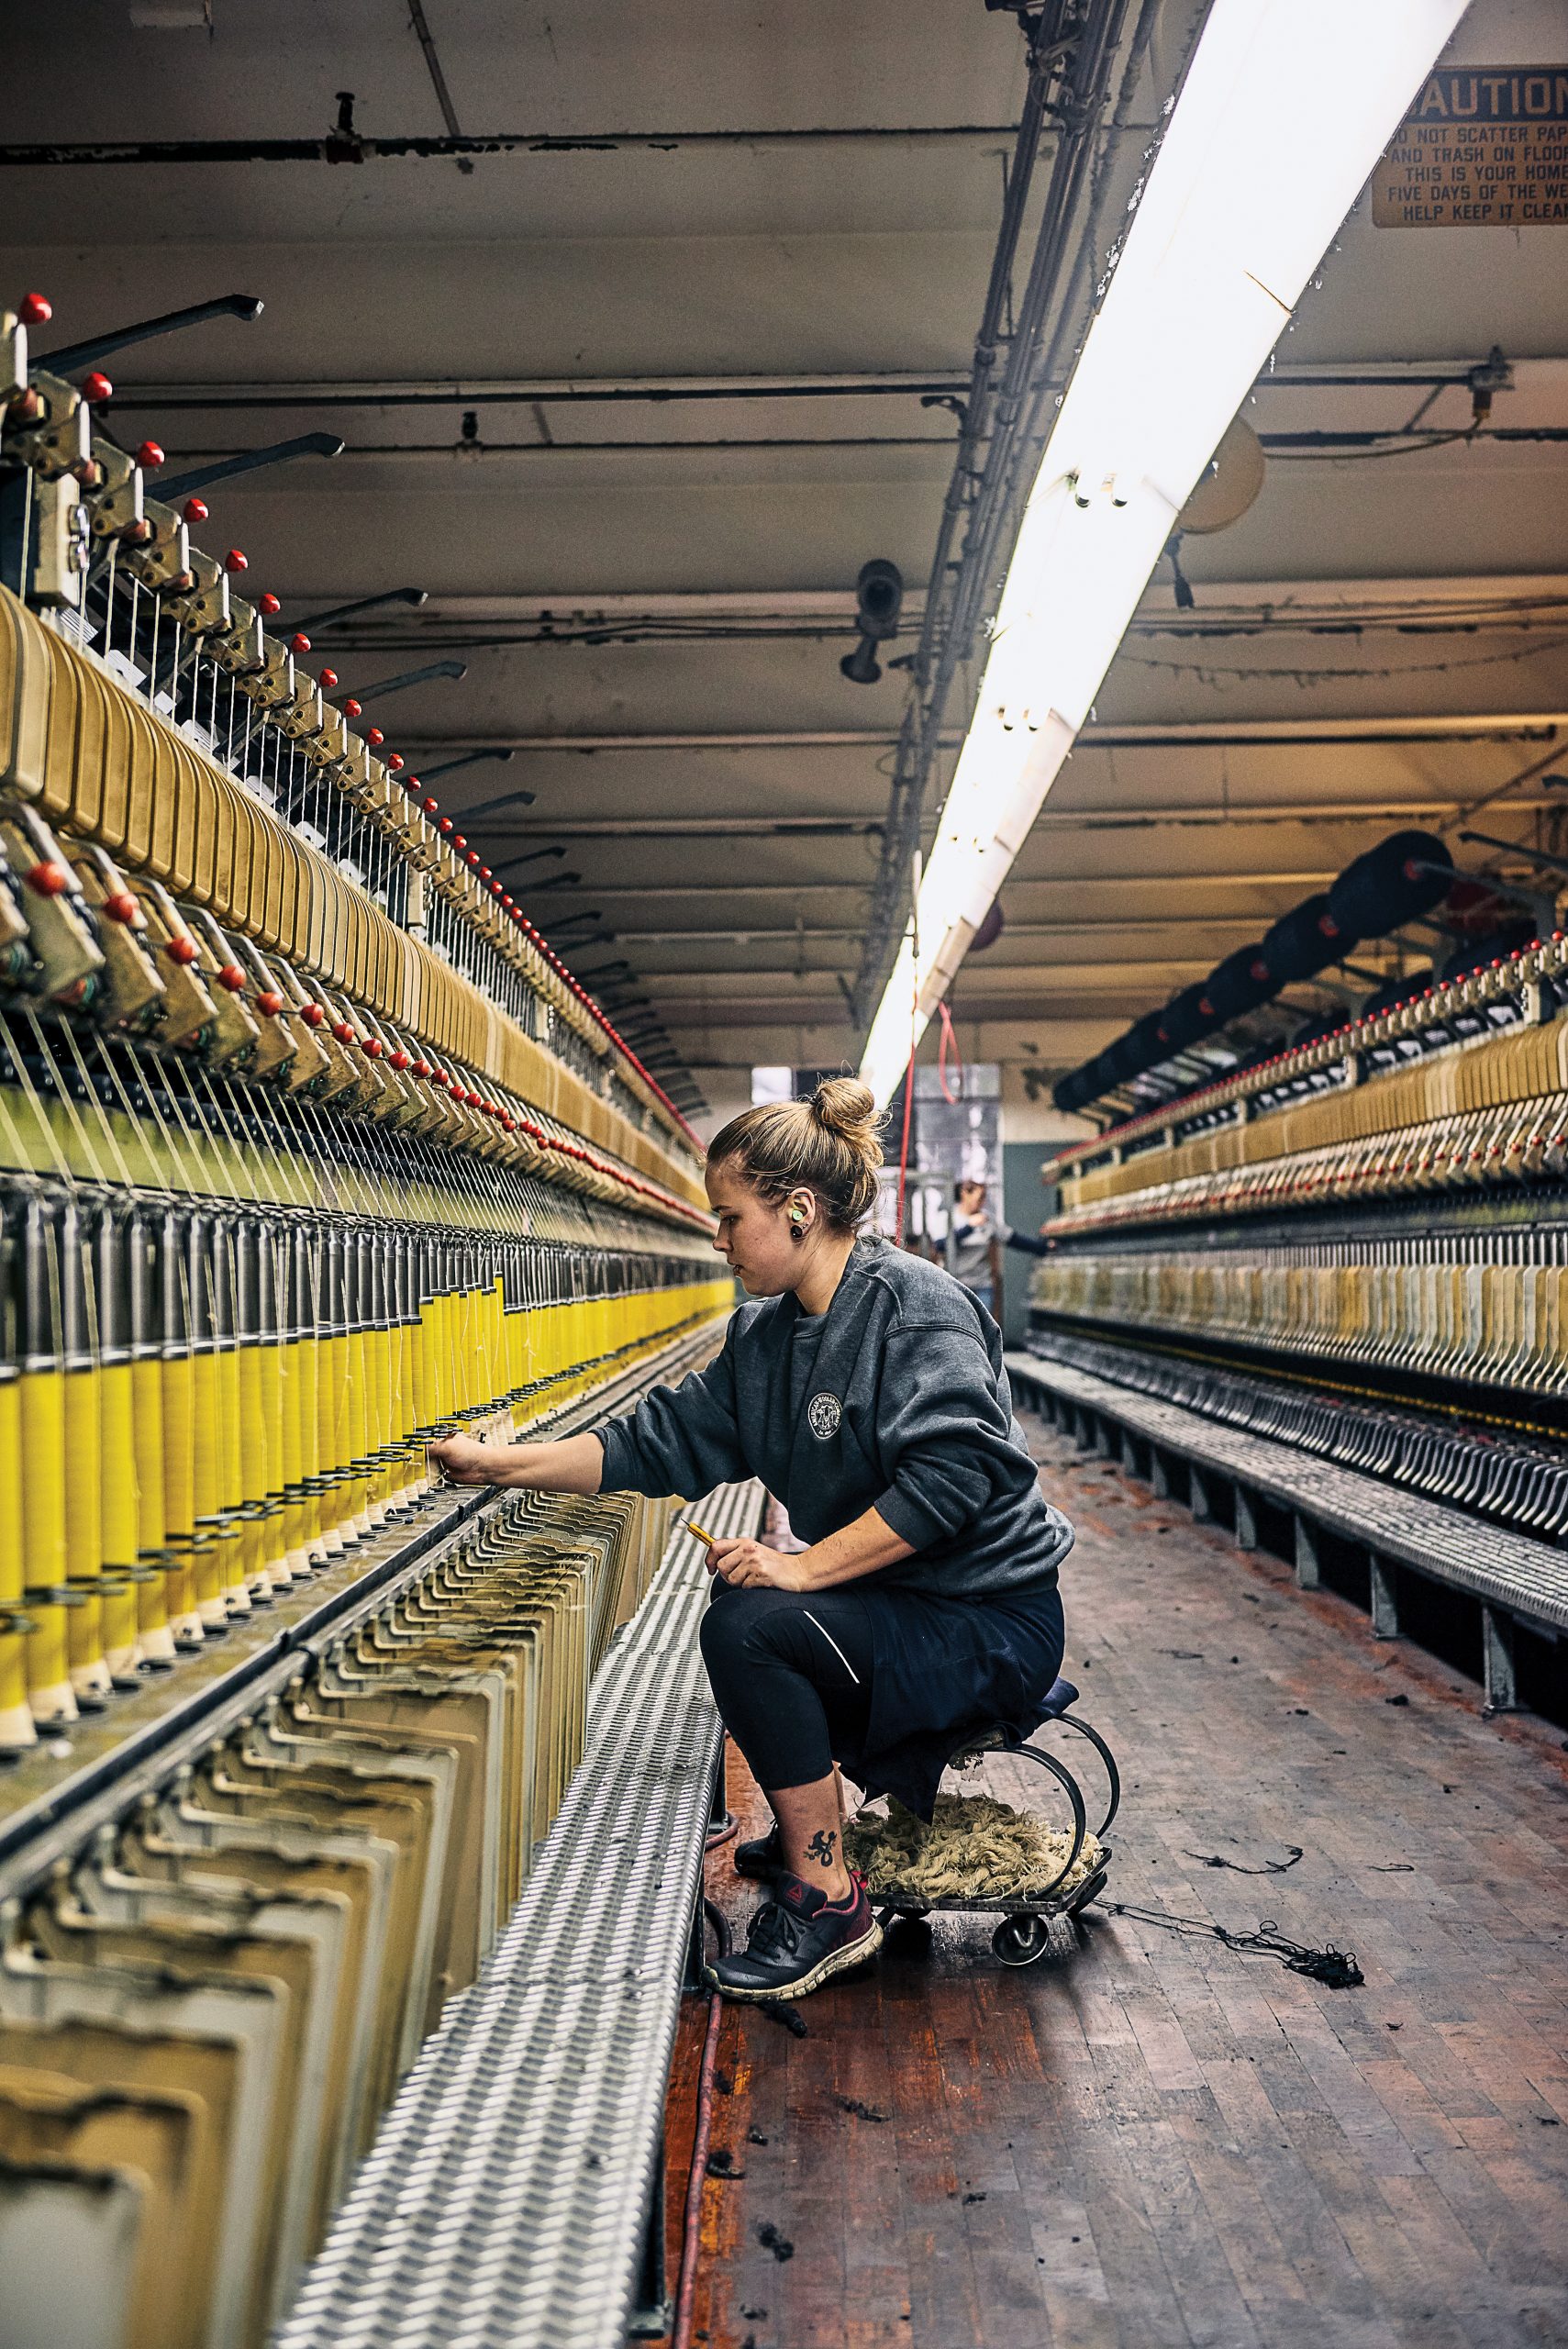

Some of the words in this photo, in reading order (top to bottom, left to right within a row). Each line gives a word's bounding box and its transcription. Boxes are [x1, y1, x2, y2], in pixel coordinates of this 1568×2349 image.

[1408, 77, 1568, 117] AUTION
[1418, 128, 1449, 144] NOT
[1457, 127, 1528, 143] SCATTER
[1391, 148, 1422, 163] AND
[1433, 147, 1484, 162] TRASH
[1494, 146, 1514, 161] ON
[1406, 167, 1442, 182] THIS
[1451, 166, 1466, 181] IS
[1474, 166, 1516, 181] YOUR
[1525, 165, 1568, 180] HOME
[1388, 186, 1422, 202] FIVE
[1430, 185, 1471, 201] DAYS
[1479, 184, 1498, 200] OF
[1507, 184, 1537, 199] THE
[1403, 206, 1444, 221] HELP
[1452, 205, 1492, 220] KEEP
[1499, 204, 1515, 219] IT
